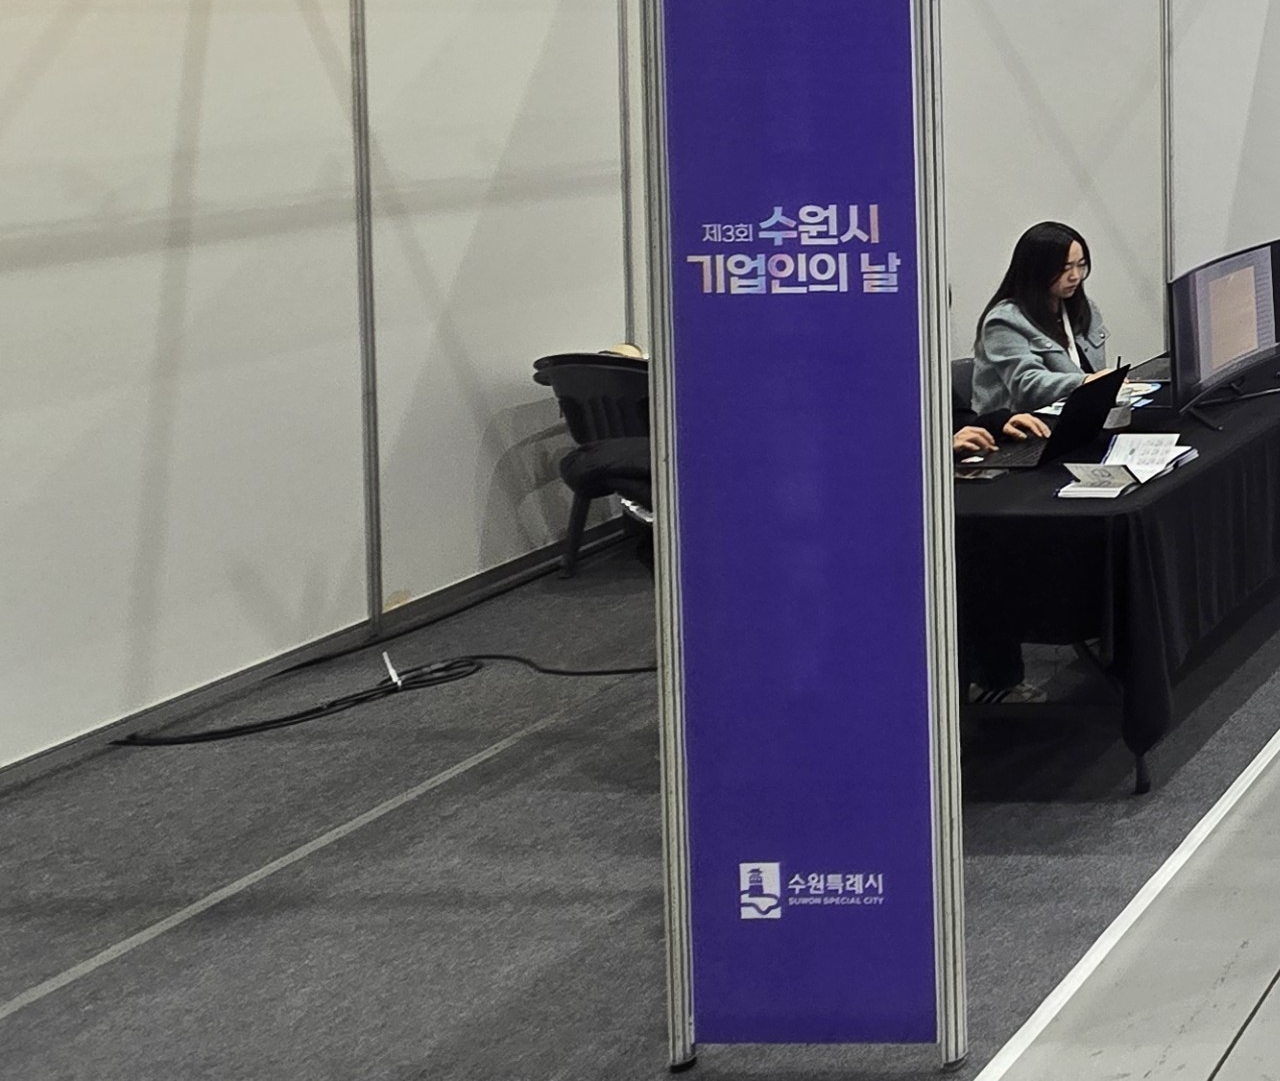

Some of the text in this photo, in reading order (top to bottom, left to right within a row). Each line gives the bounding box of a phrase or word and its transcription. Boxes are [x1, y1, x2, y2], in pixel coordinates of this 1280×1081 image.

[702, 204, 880, 247] 제3회 수원시
[686, 252, 901, 295] 기업인의 날
[788, 873, 884, 895] 수원특례시
[788, 897, 884, 905] SUWON SPECIAL CITY
